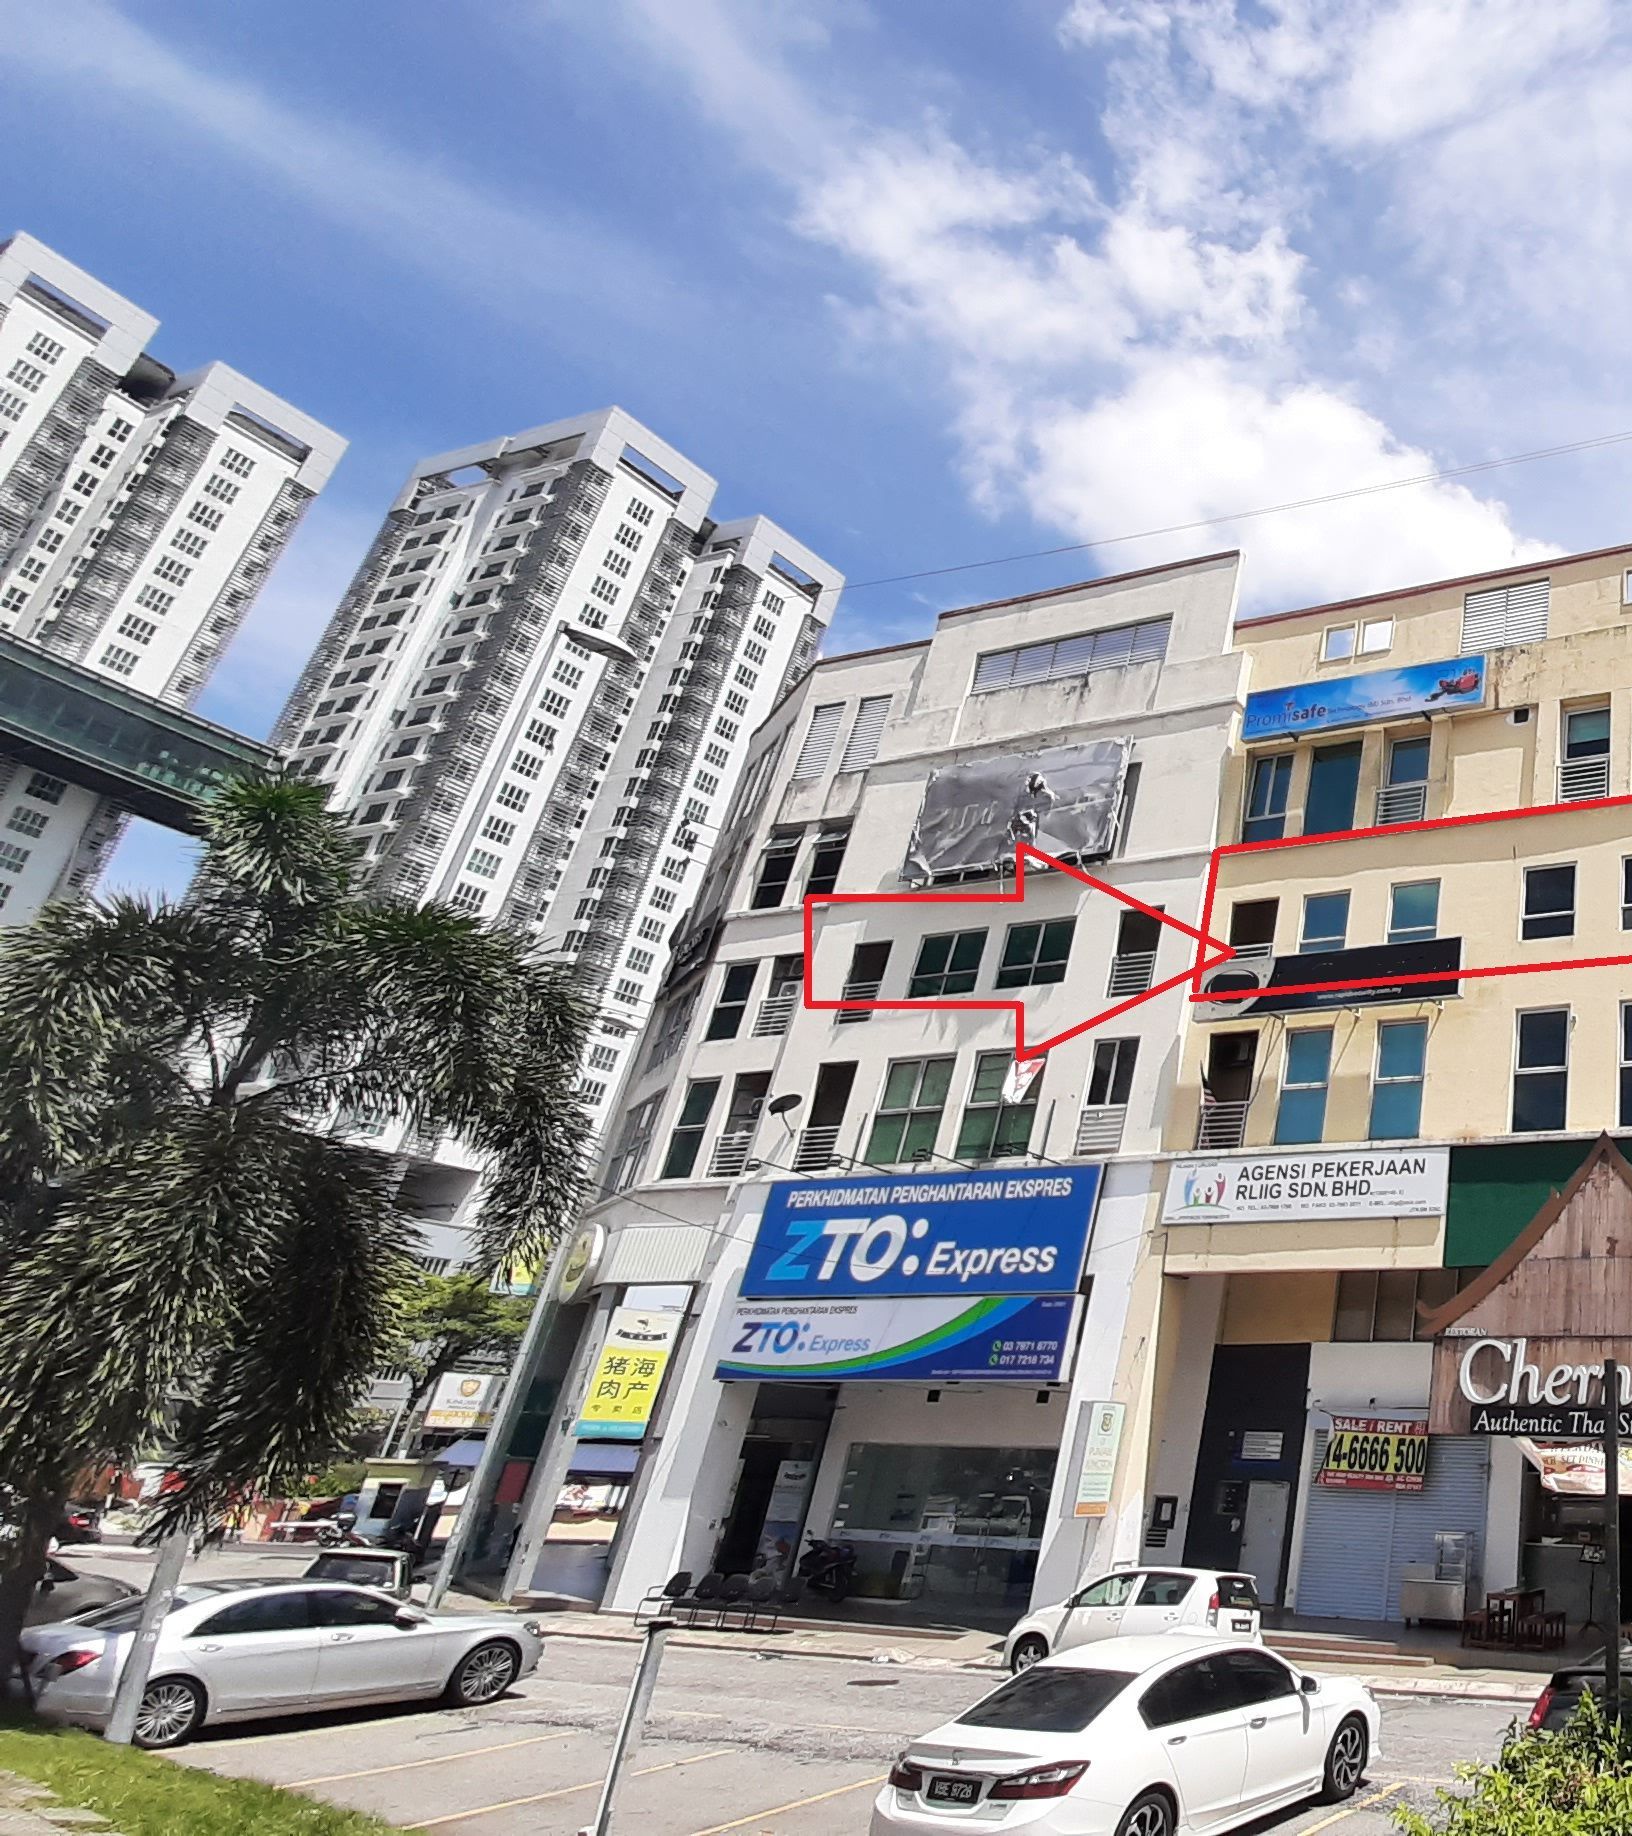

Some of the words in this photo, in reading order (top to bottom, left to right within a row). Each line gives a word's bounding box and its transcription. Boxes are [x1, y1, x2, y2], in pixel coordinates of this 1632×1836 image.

[1237, 1163, 1306, 1182] AGENSI
[1312, 1158, 1426, 1179] PEKERJAAN
[786, 1187, 889, 1209] PERKHIDMATAN
[890, 1182, 1002, 1204] PENGHANTARAN
[1004, 1177, 1073, 1199] EKSPRES
[926, 1240, 1058, 1283] Express
[809, 1335, 871, 1355] Express
[1334, 1419, 1368, 1432] SALE
[1376, 1421, 1413, 1434] RENT
[1473, 1408, 1563, 1435] Authentic
[1568, 1411, 1606, 1435] Tha
[1394, 1437, 1426, 1473] 500
